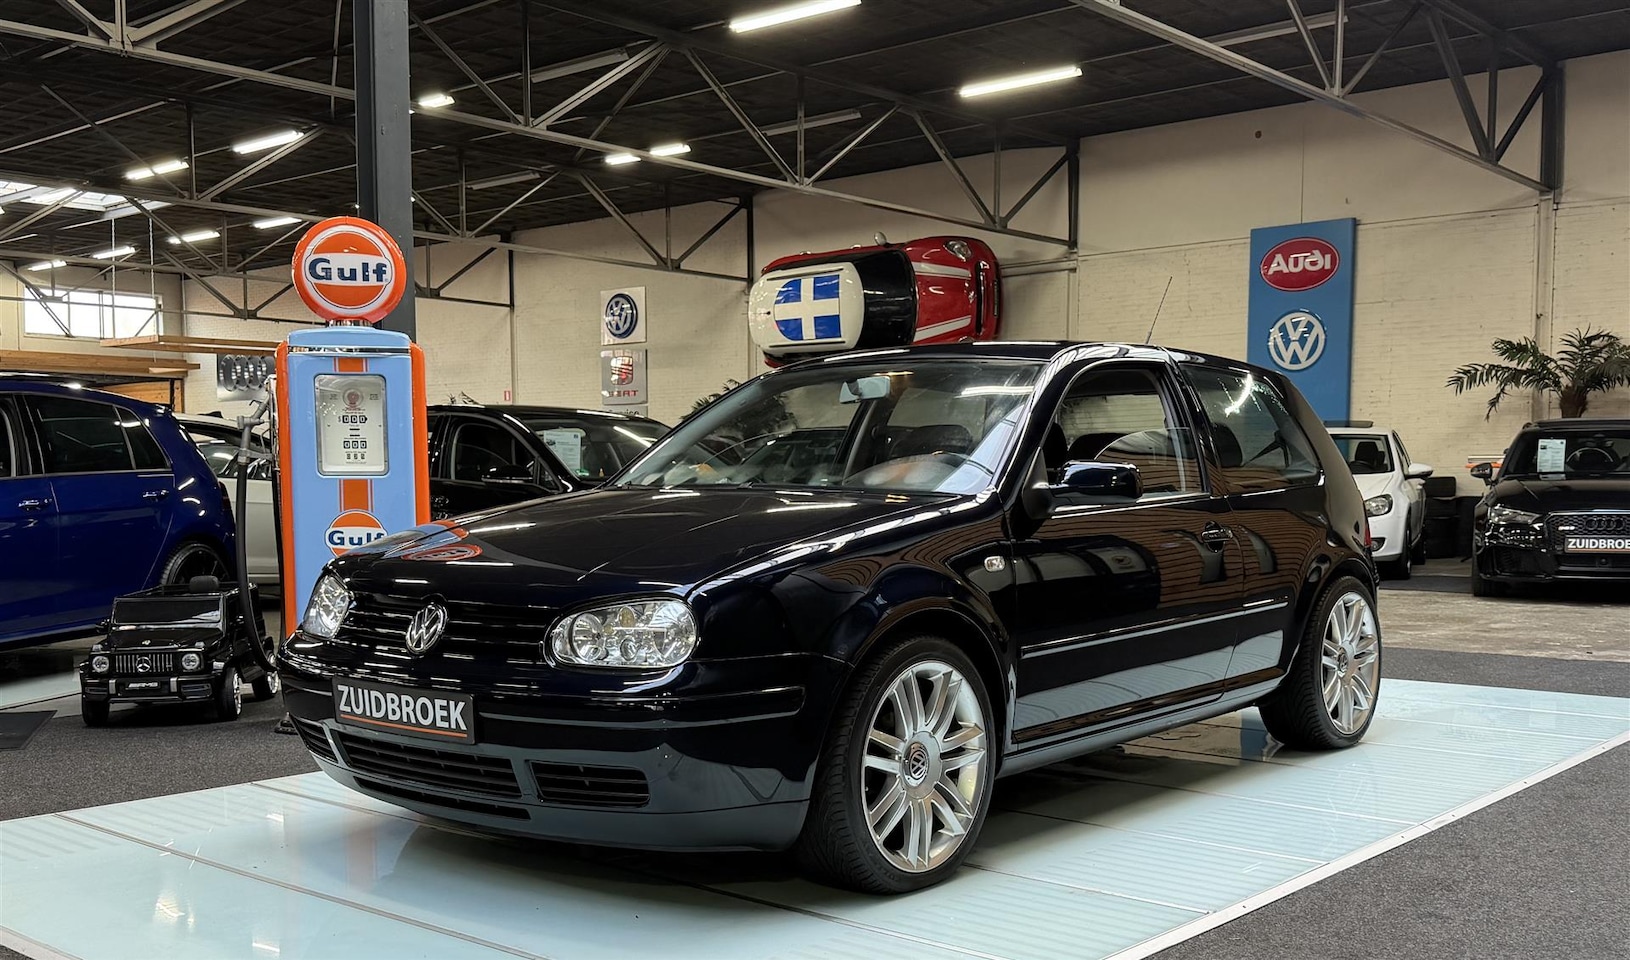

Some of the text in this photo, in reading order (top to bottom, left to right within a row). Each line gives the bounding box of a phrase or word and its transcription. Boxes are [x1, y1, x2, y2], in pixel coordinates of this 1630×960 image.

[308, 257, 387, 282] Gulf
[1269, 312, 1325, 370] VW
[337, 684, 467, 731] ZUIDBROEK
